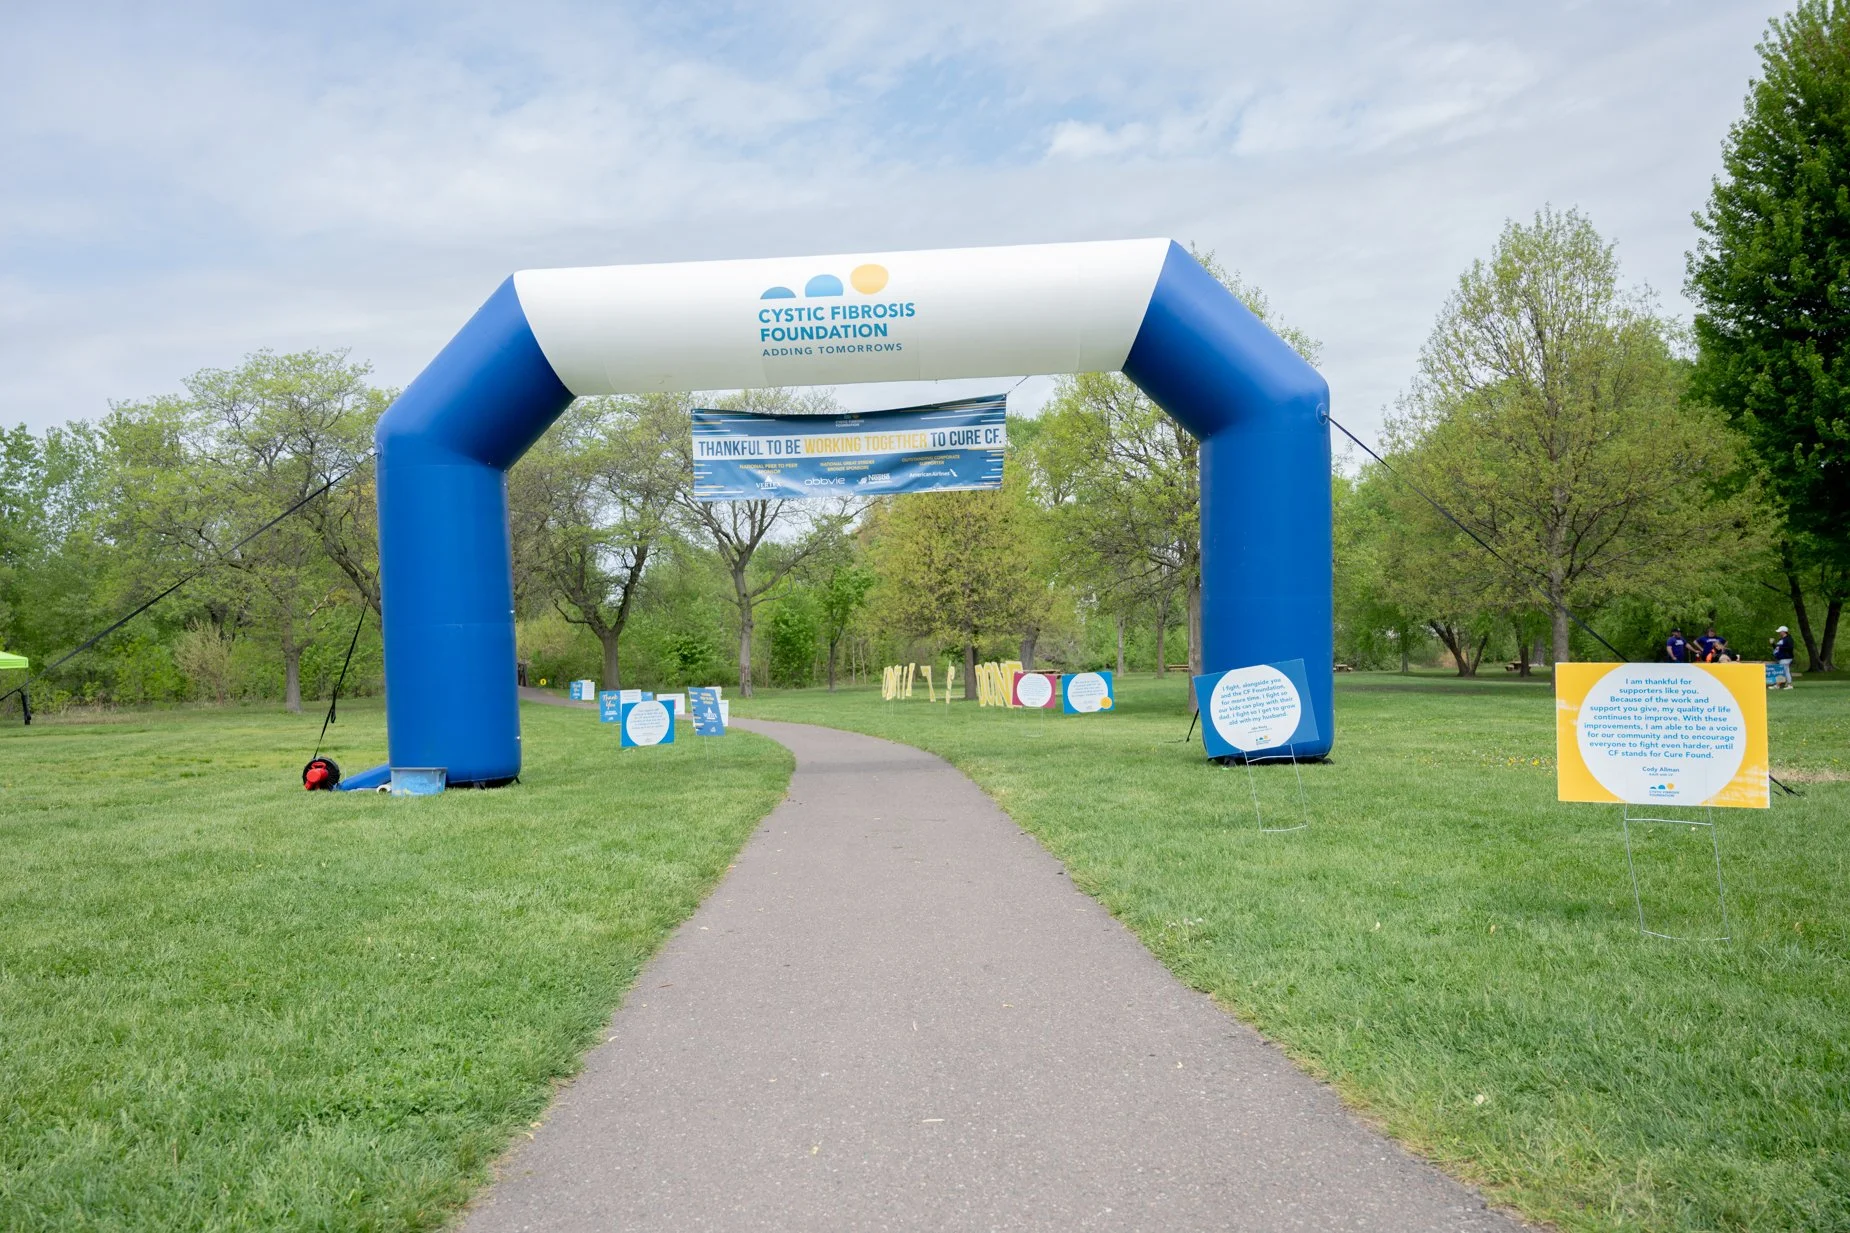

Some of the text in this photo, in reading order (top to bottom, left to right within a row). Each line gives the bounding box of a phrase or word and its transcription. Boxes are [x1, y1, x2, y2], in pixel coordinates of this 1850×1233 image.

[759, 302, 915, 323] CYSTIC FIBROSIS
[760, 323, 887, 342] FOUNDATION
[762, 342, 902, 357] ADDING TOMORROWS
[698, 428, 1002, 456] THANKFUL TO BE WORKING TOGETHER TO CURE CF.
[804, 477, 846, 486] abbvie
[1242, 679, 1269, 688] alongside
[1251, 684, 1285, 693] Foundation,
[1639, 705, 1659, 713] give,
[1676, 705, 1704, 714] quality
[1261, 711, 1288, 720] husband.
[1644, 714, 1680, 722] improve.
[1616, 732, 1660, 740] community
[1691, 734, 1735, 742] encourage
[1639, 740, 1658, 749] fight
[1682, 742, 1712, 750] harder,
